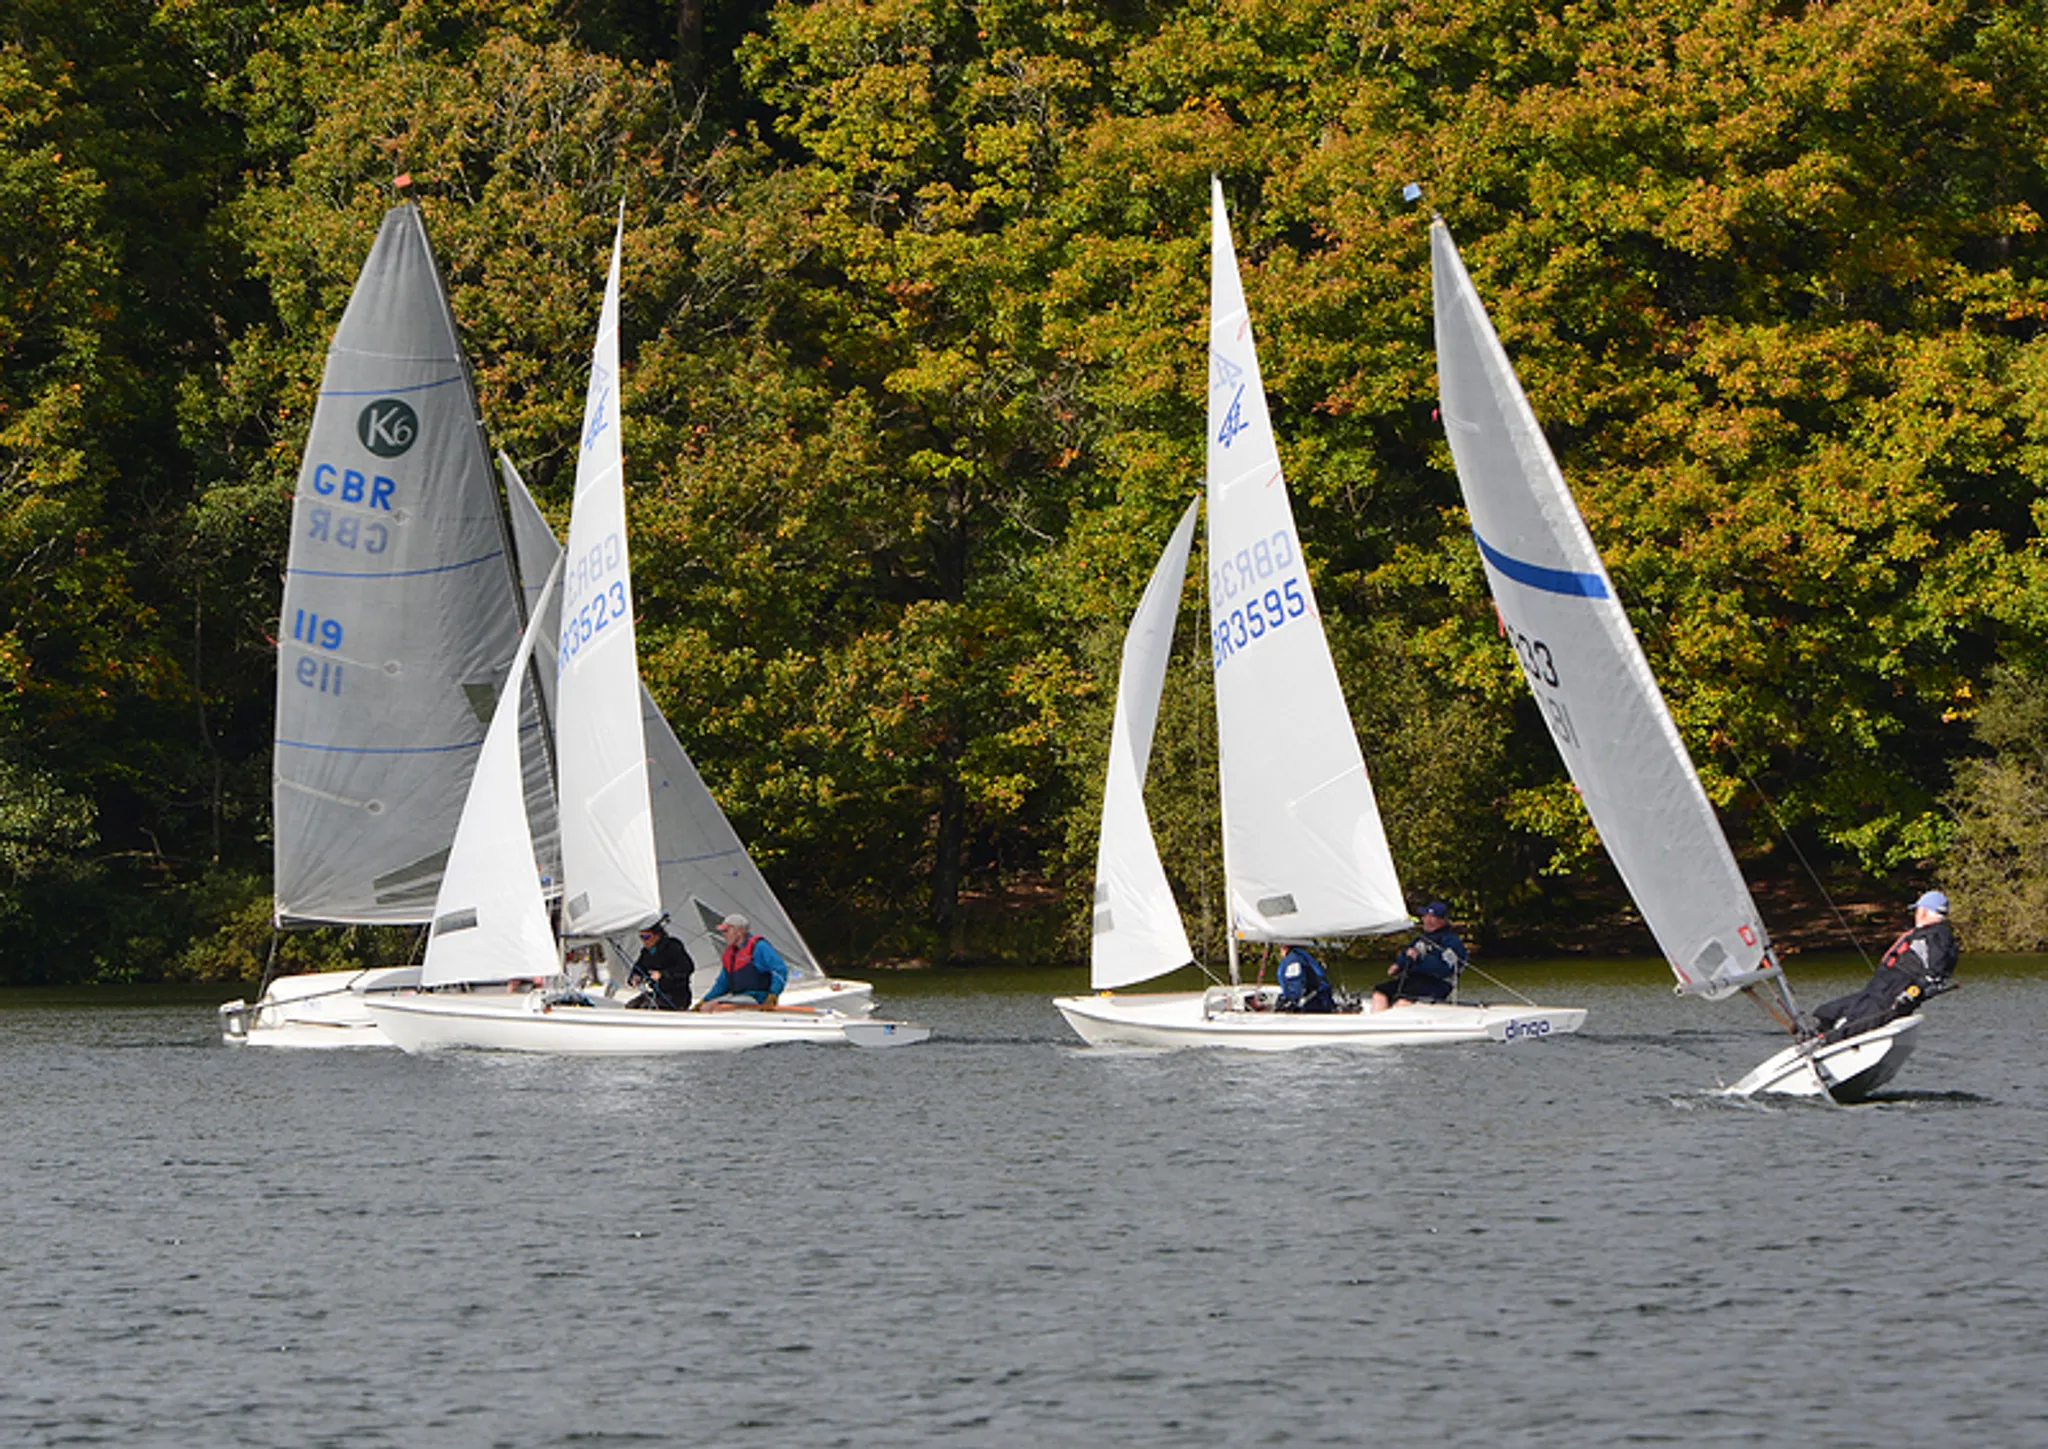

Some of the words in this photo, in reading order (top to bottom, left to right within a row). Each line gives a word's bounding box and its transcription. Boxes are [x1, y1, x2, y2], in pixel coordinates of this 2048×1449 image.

[367, 407, 413, 447] K6
[313, 463, 396, 511] GBR
[294, 608, 343, 650] 119
[1505, 1018, 1550, 1040] dingo
